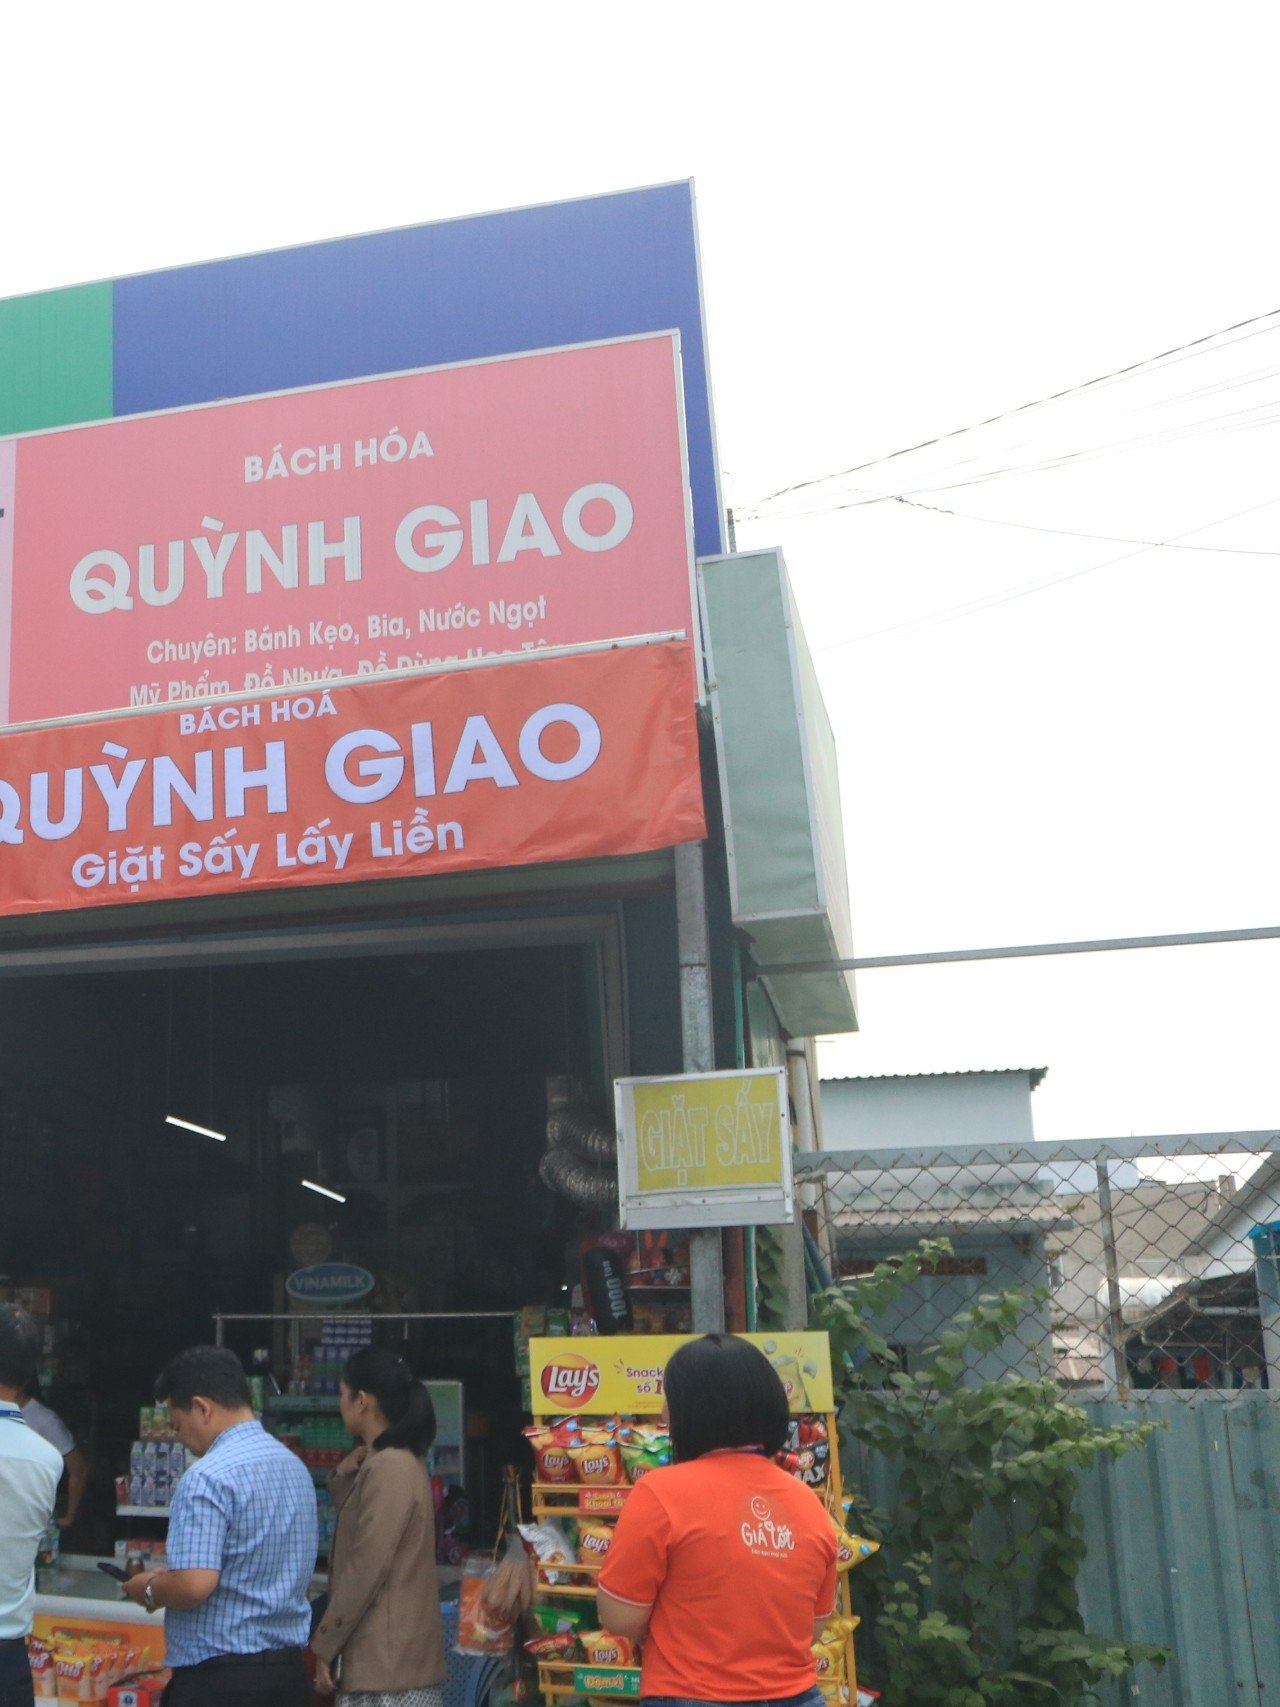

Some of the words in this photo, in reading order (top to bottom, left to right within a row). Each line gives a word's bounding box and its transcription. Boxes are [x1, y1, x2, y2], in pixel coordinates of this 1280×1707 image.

[243, 442, 343, 483] BÁCH
[352, 426, 435, 468] HÓA
[68, 514, 362, 616] QUỲNH
[393, 482, 635, 574] GIAO
[146, 628, 238, 665] Chuyên:
[244, 620, 301, 653] Bánh
[308, 614, 362, 649] Kẹo,
[367, 612, 413, 641] Bia,
[418, 600, 482, 634] Nước
[488, 595, 548, 630] Ngọt
[179, 699, 261, 737] BÁCH
[270, 687, 338, 724] HOÁ
[324, 702, 602, 805] GIAO
[71, 836, 167, 894] Giặt
[178, 828, 261, 881] Sấy
[275, 818, 355, 870] Lấy
[371, 807, 465, 858] Liền
[640, 1094, 710, 1186] GIẶT
[715, 1079, 774, 1167] SẤY
[293, 1274, 365, 1291] VINAMILK
[626, 1367, 665, 1378] Snack
[637, 1380, 652, 1393] số
